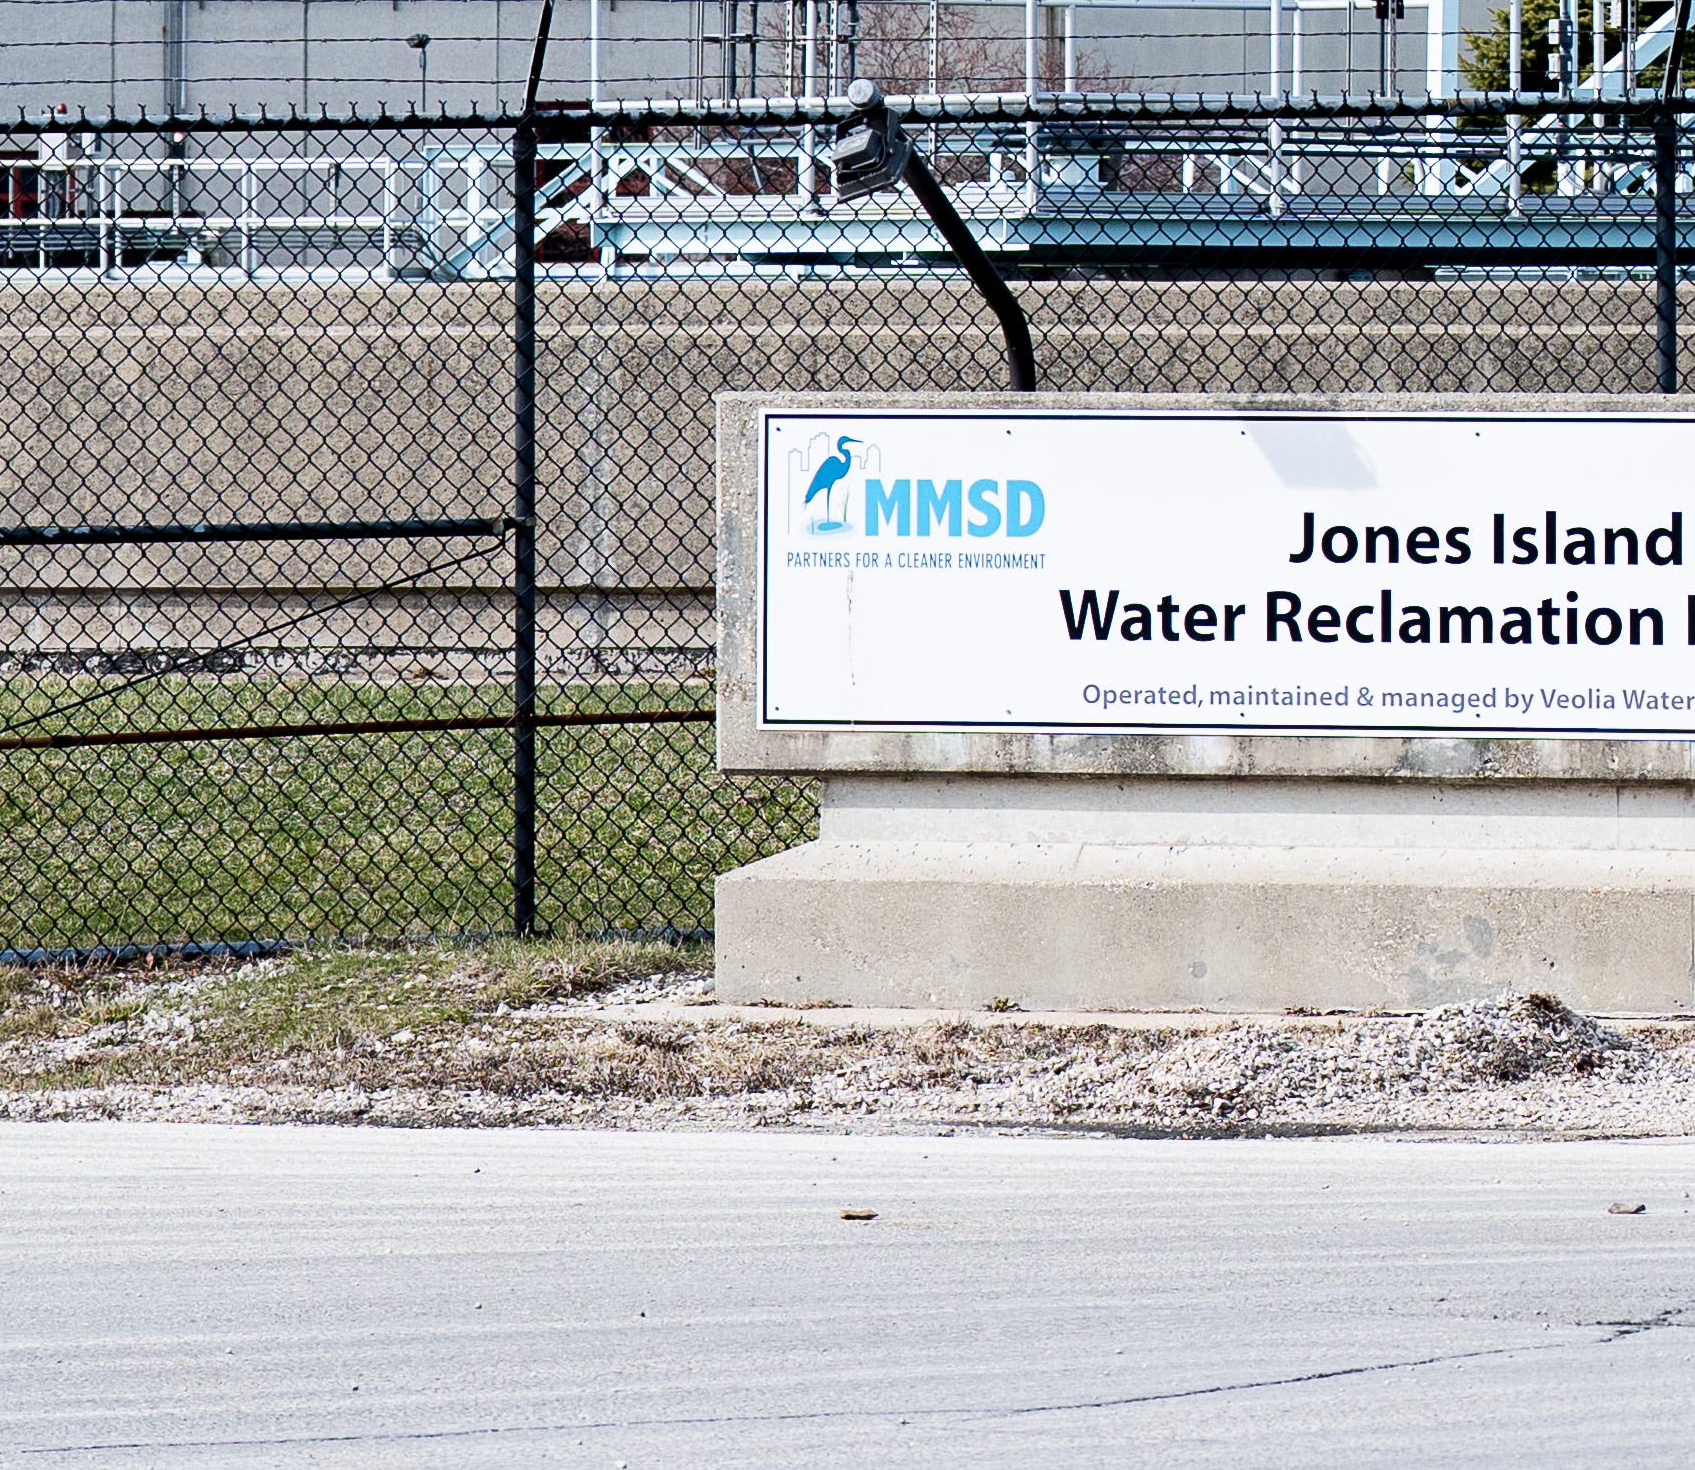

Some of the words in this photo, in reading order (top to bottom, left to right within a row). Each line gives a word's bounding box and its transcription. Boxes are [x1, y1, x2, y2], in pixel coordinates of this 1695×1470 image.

[865, 479, 1045, 537] MMSD
[788, 552, 850, 567] PARTNERS
[856, 553, 878, 567] FOR
[885, 553, 892, 567] A
[899, 553, 951, 568] CLEANER
[959, 553, 1045, 569] ENVIRONMENT
[1289, 512, 1471, 564] Jones
[1494, 511, 1682, 566] Island
[1059, 590, 1245, 641] Water
[1267, 590, 1663, 645] Reclamation
[1083, 684, 1203, 709] Operated,
[1210, 685, 1348, 706] maintained
[1357, 687, 1373, 706] &
[1382, 688, 1496, 713] managed
[1506, 688, 1534, 714] by
[1540, 688, 1615, 709] Veolia
[1622, 690, 1695, 710] Water
